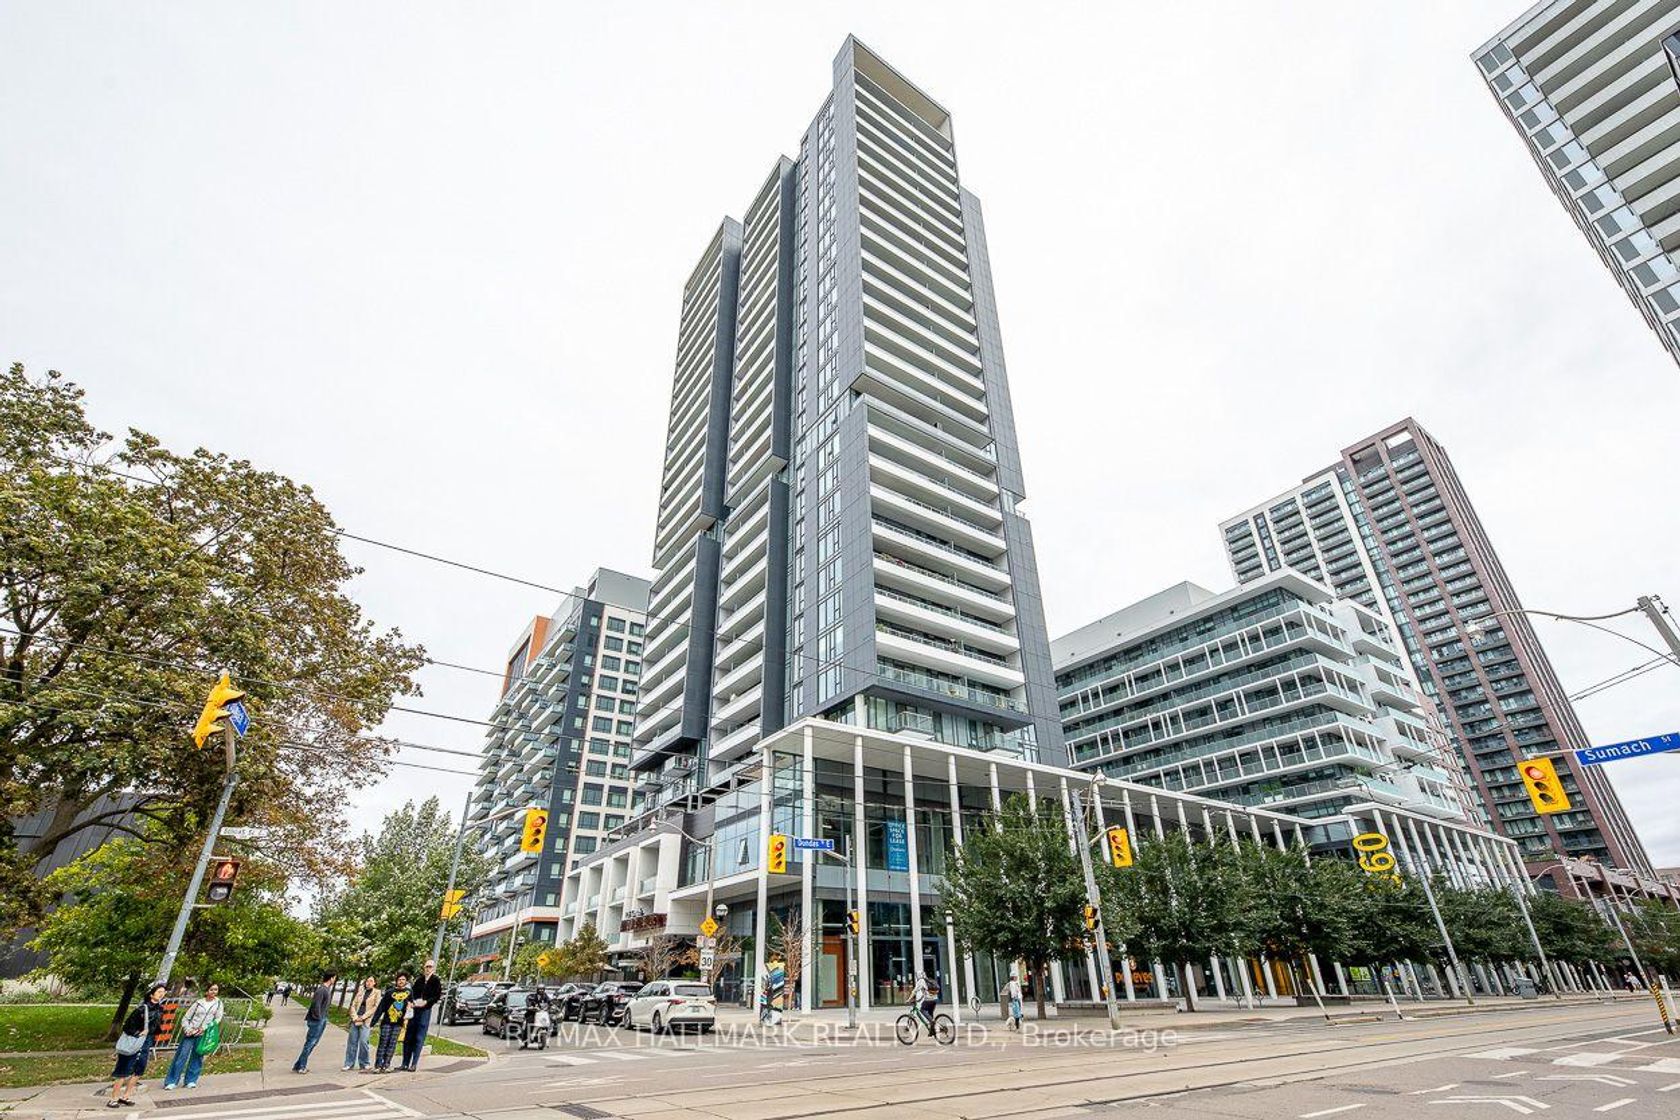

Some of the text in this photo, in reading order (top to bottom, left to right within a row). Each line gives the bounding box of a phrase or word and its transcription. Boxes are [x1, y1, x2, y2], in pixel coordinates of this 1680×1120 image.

[1584, 740, 1652, 760] Sumach
[797, 839, 820, 848] Dundas
[826, 839, 831, 848] E
[702, 957, 712, 966] 30
